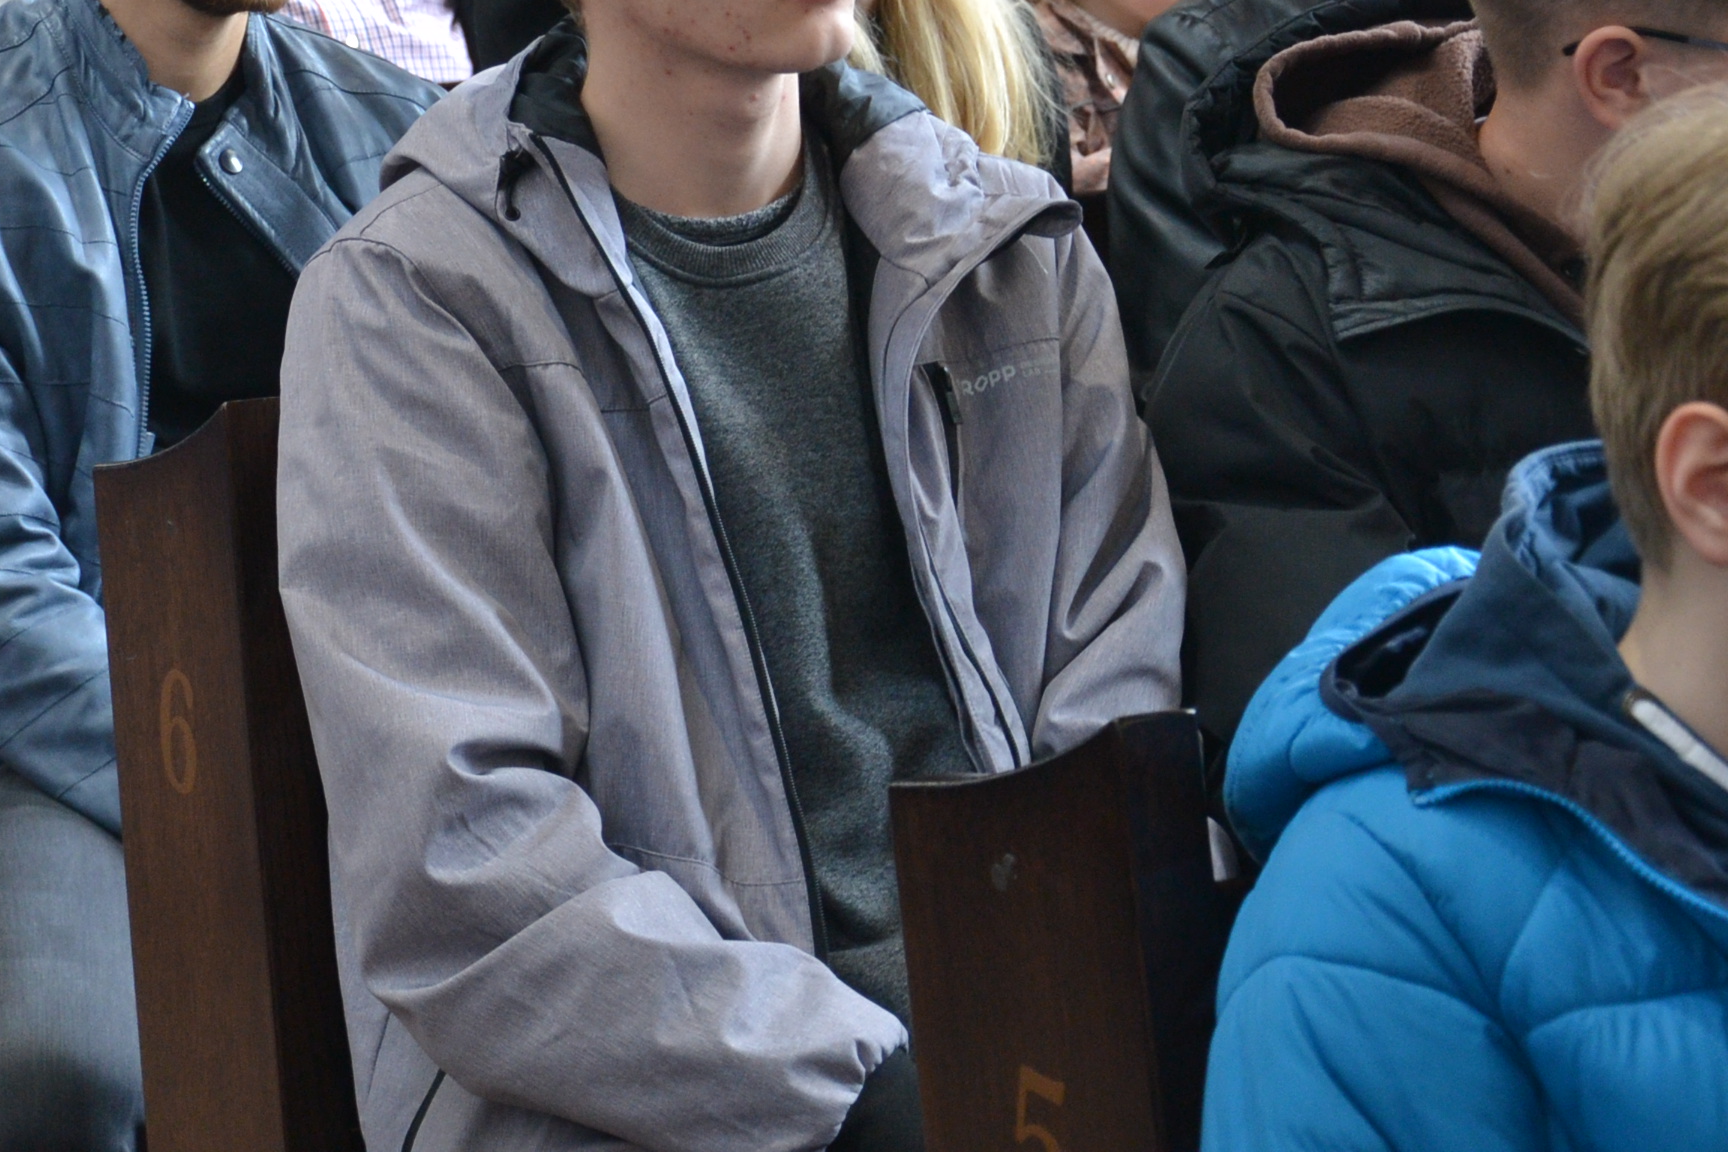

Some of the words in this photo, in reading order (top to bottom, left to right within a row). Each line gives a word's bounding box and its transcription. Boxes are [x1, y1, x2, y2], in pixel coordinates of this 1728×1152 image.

[956, 364, 1016, 396] ROPP
[160, 668, 197, 795] 6
[1015, 1064, 1066, 1152] 5
